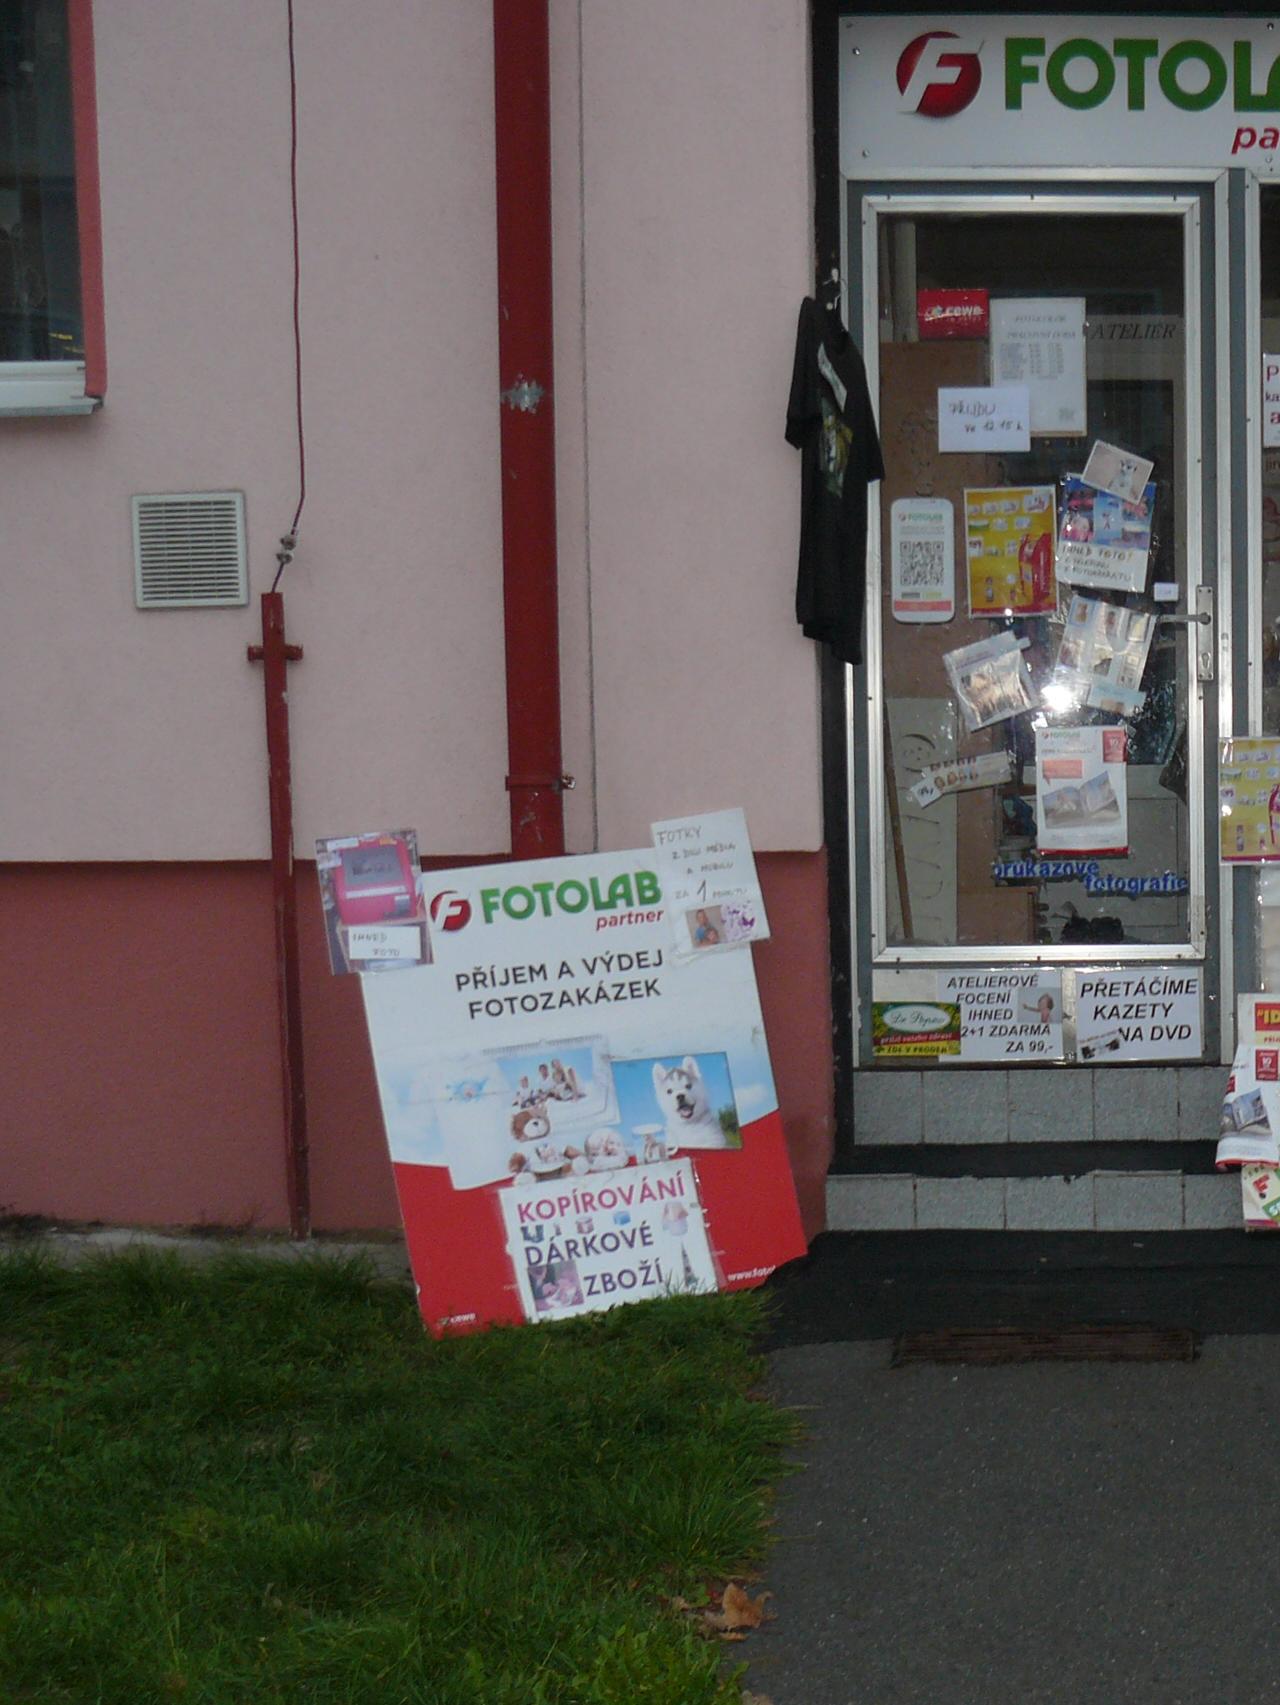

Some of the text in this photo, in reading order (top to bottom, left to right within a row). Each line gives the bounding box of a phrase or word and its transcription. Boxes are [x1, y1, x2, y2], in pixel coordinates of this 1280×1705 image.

[1270, 412, 1280, 424] a
[482, 870, 663, 926] FOTOLAB
[596, 907, 664, 932] partner
[456, 949, 664, 991] PŘÍJEM A VÝDEJ
[947, 973, 1039, 989] ATELIEROVÉ
[1080, 975, 1197, 999] PŘETÁČÍME
[469, 976, 662, 1020] FOTOZAKÁZEK
[956, 991, 1010, 1004] FOCENÍ
[968, 1008, 1014, 1021] IHNED
[1093, 1002, 1174, 1020] KAZETY
[961, 1024, 1051, 1038] 2+1 ZDARMA
[1119, 1025, 1192, 1043] NA DVD
[1006, 1041, 1026, 1053] ZA
[517, 1169, 686, 1224] KOPÍROVÁNÍ
[525, 1219, 654, 1267] DÁRKOVÉ
[584, 1257, 664, 1297] ZBOŽÍ
